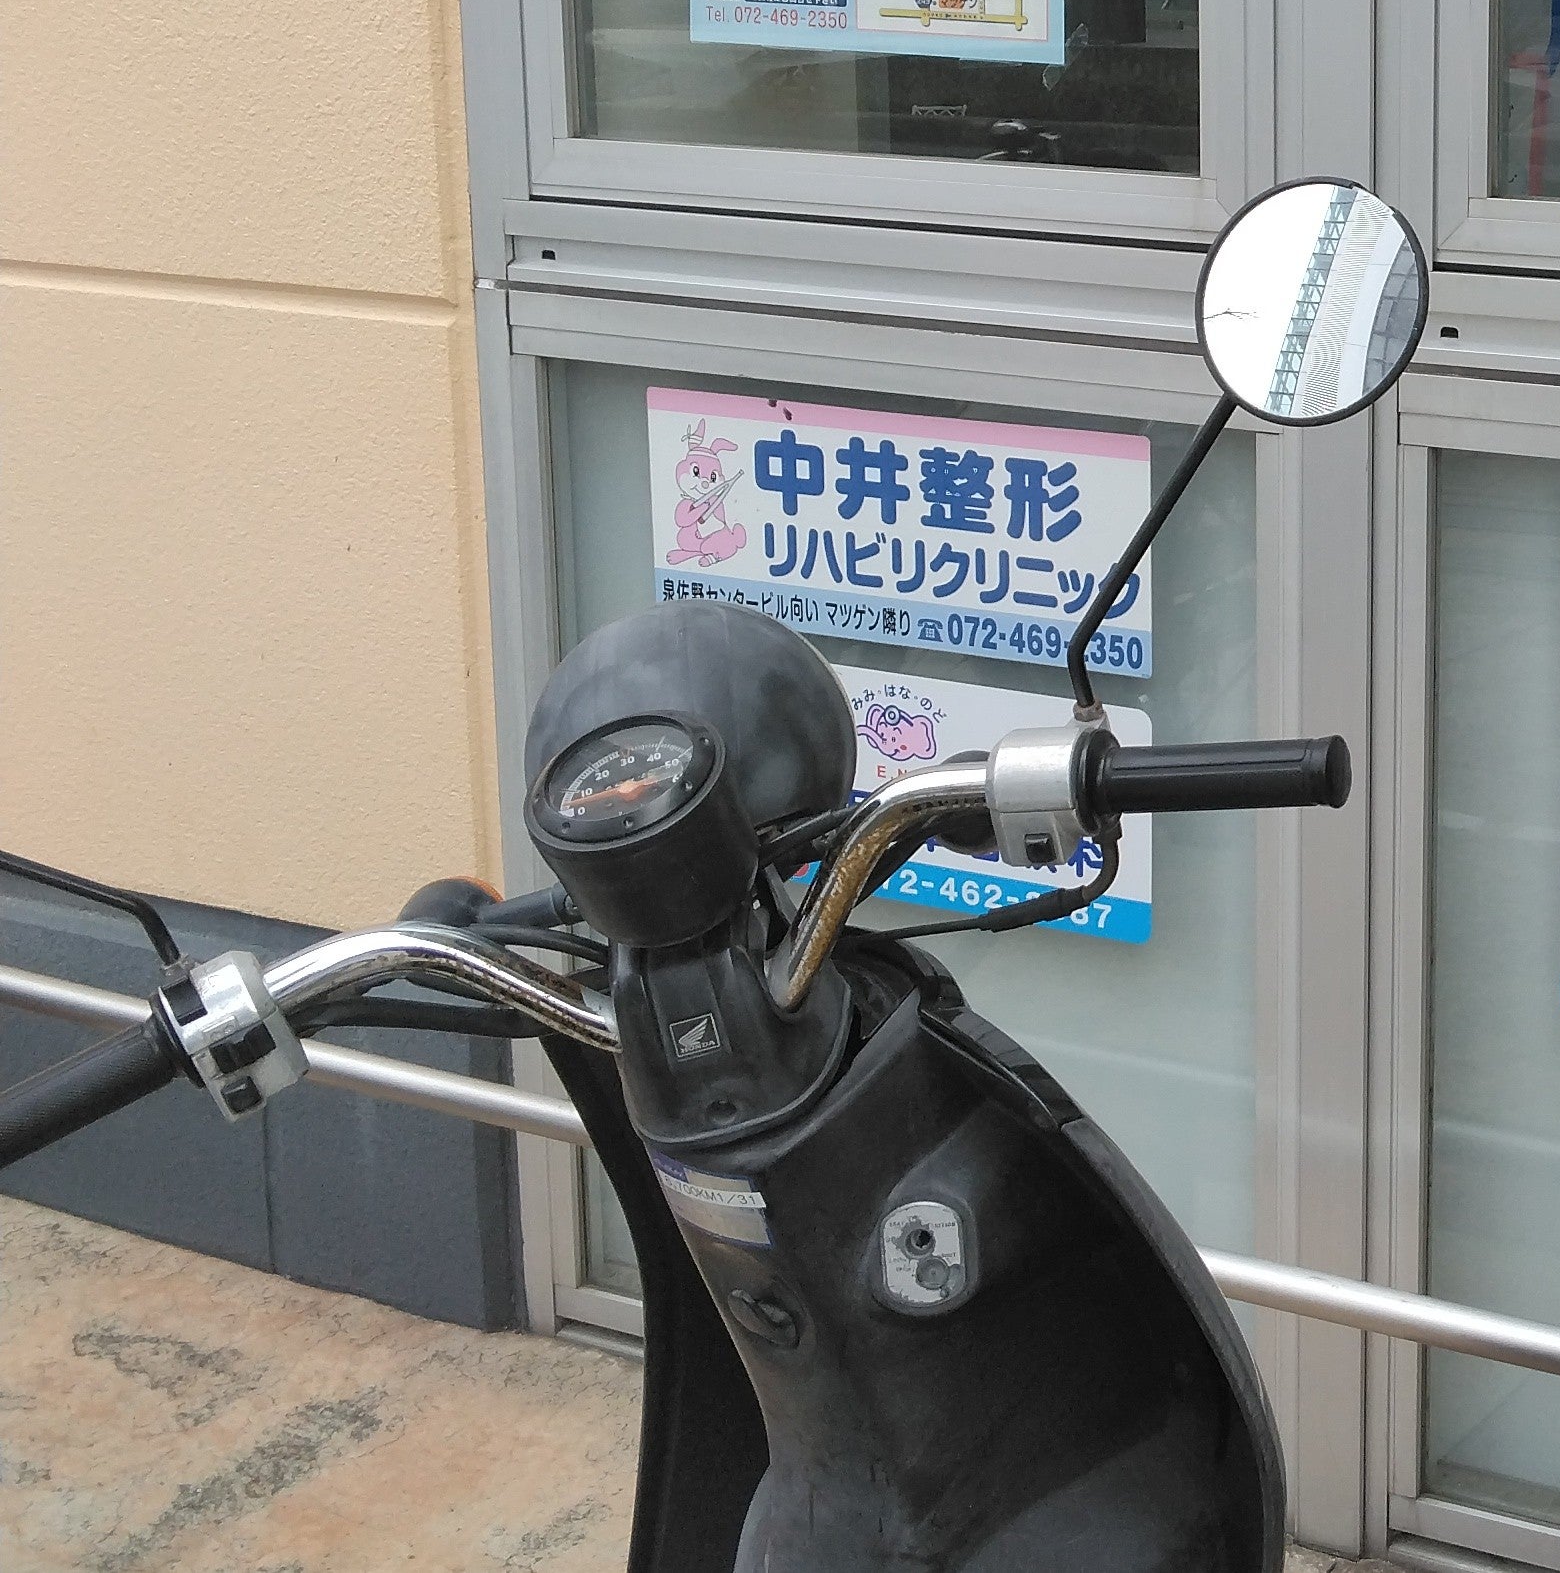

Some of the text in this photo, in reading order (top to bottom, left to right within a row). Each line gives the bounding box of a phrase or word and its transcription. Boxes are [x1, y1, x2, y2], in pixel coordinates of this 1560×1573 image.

[734, 6, 847, 29] 072-469-2350
[753, 429, 1082, 543] 中井整形
[763, 522, 1141, 620] リハビリクリニック
[825, 600, 911, 637] マツゲン隣り
[947, 616, 1144, 671] 072-469-350
